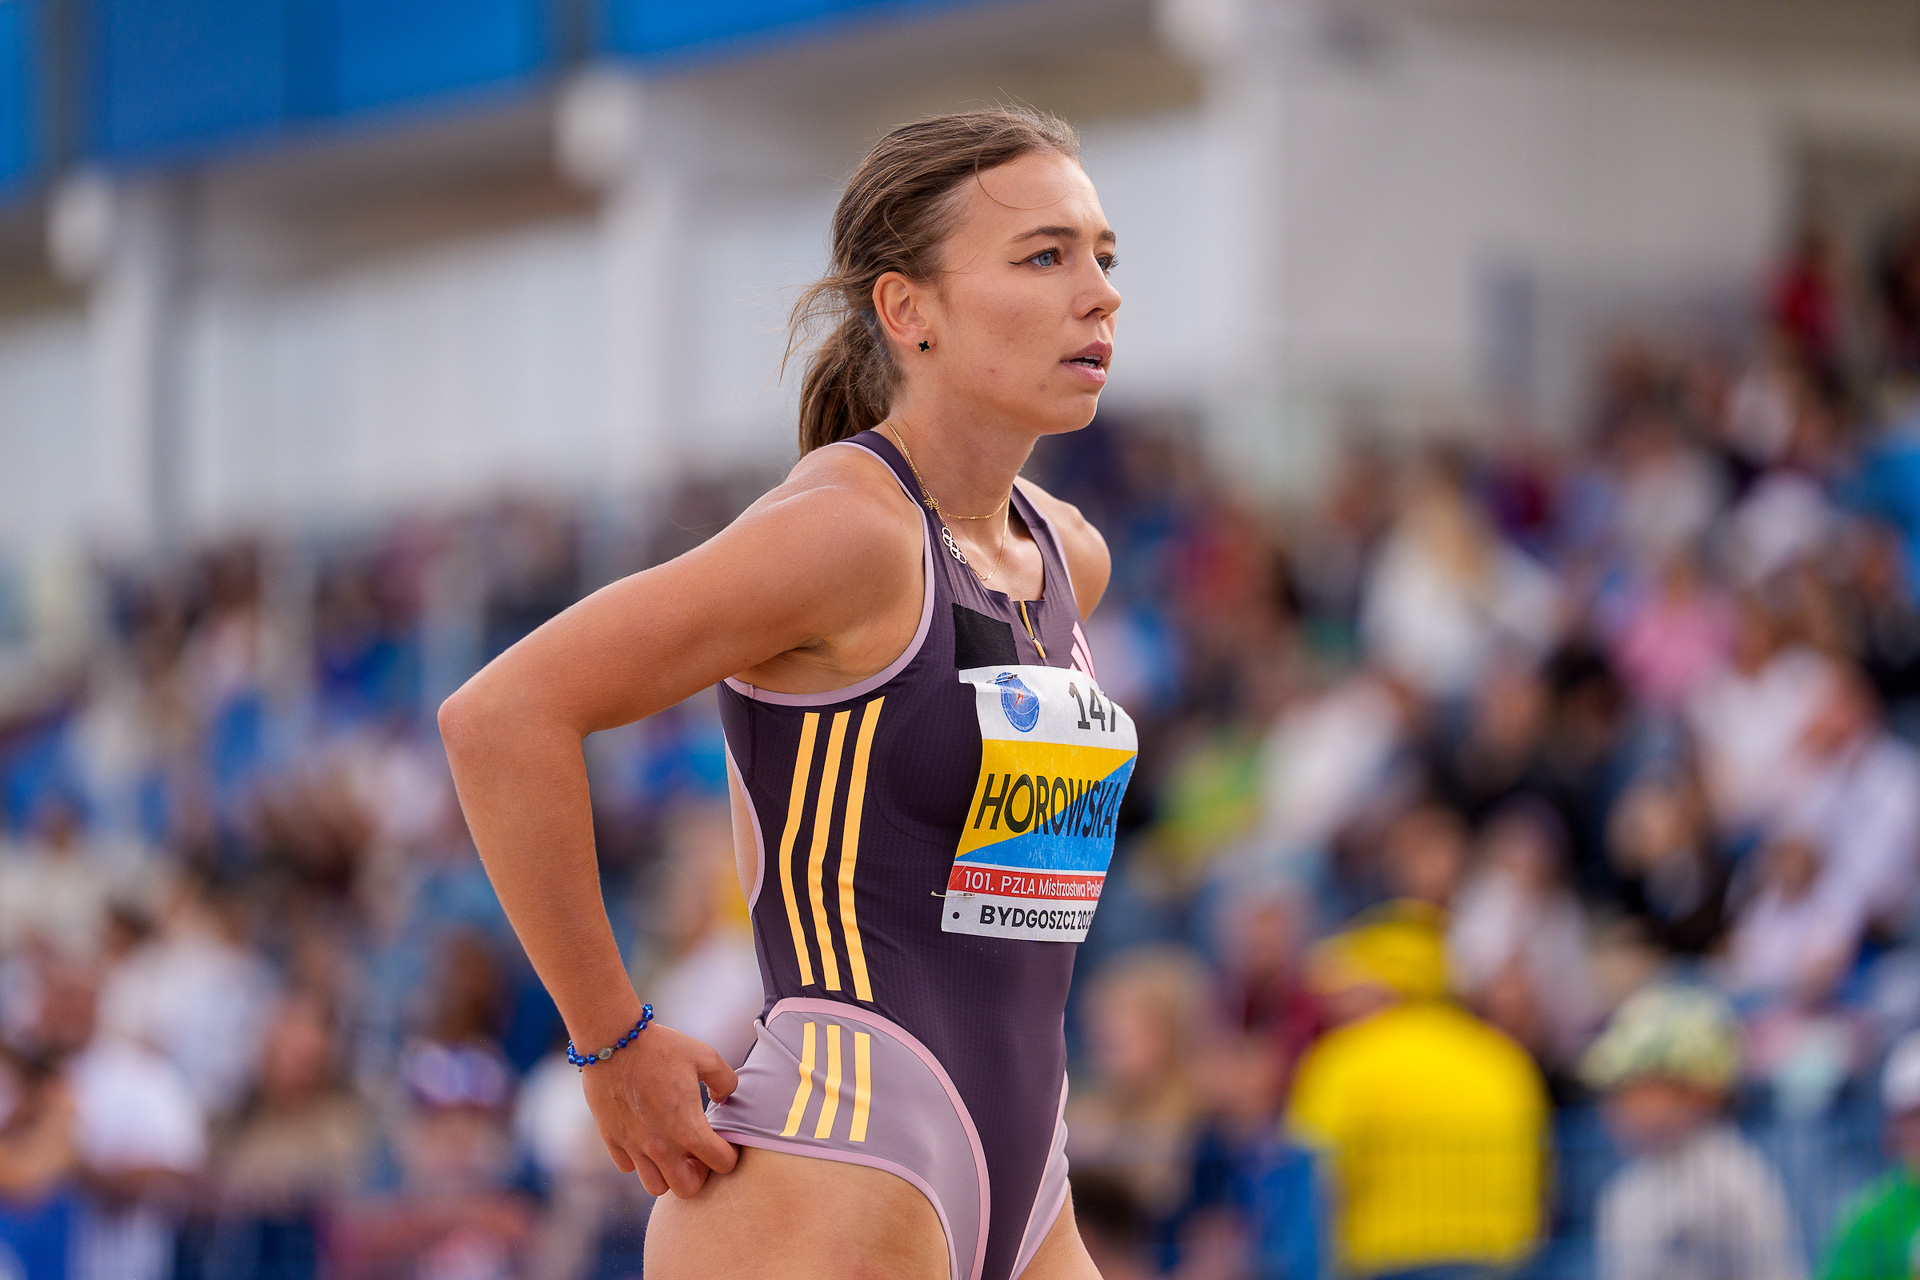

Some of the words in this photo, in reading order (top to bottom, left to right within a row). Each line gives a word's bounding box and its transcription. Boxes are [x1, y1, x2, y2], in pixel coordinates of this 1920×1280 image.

[973, 773, 1121, 838] HOROWSKA
[965, 870, 995, 892] 101.
[1000, 875, 1035, 895] PZLA
[1038, 877, 1086, 897] Mistrzostwa
[980, 904, 1077, 930] BYDGOSZCZ
